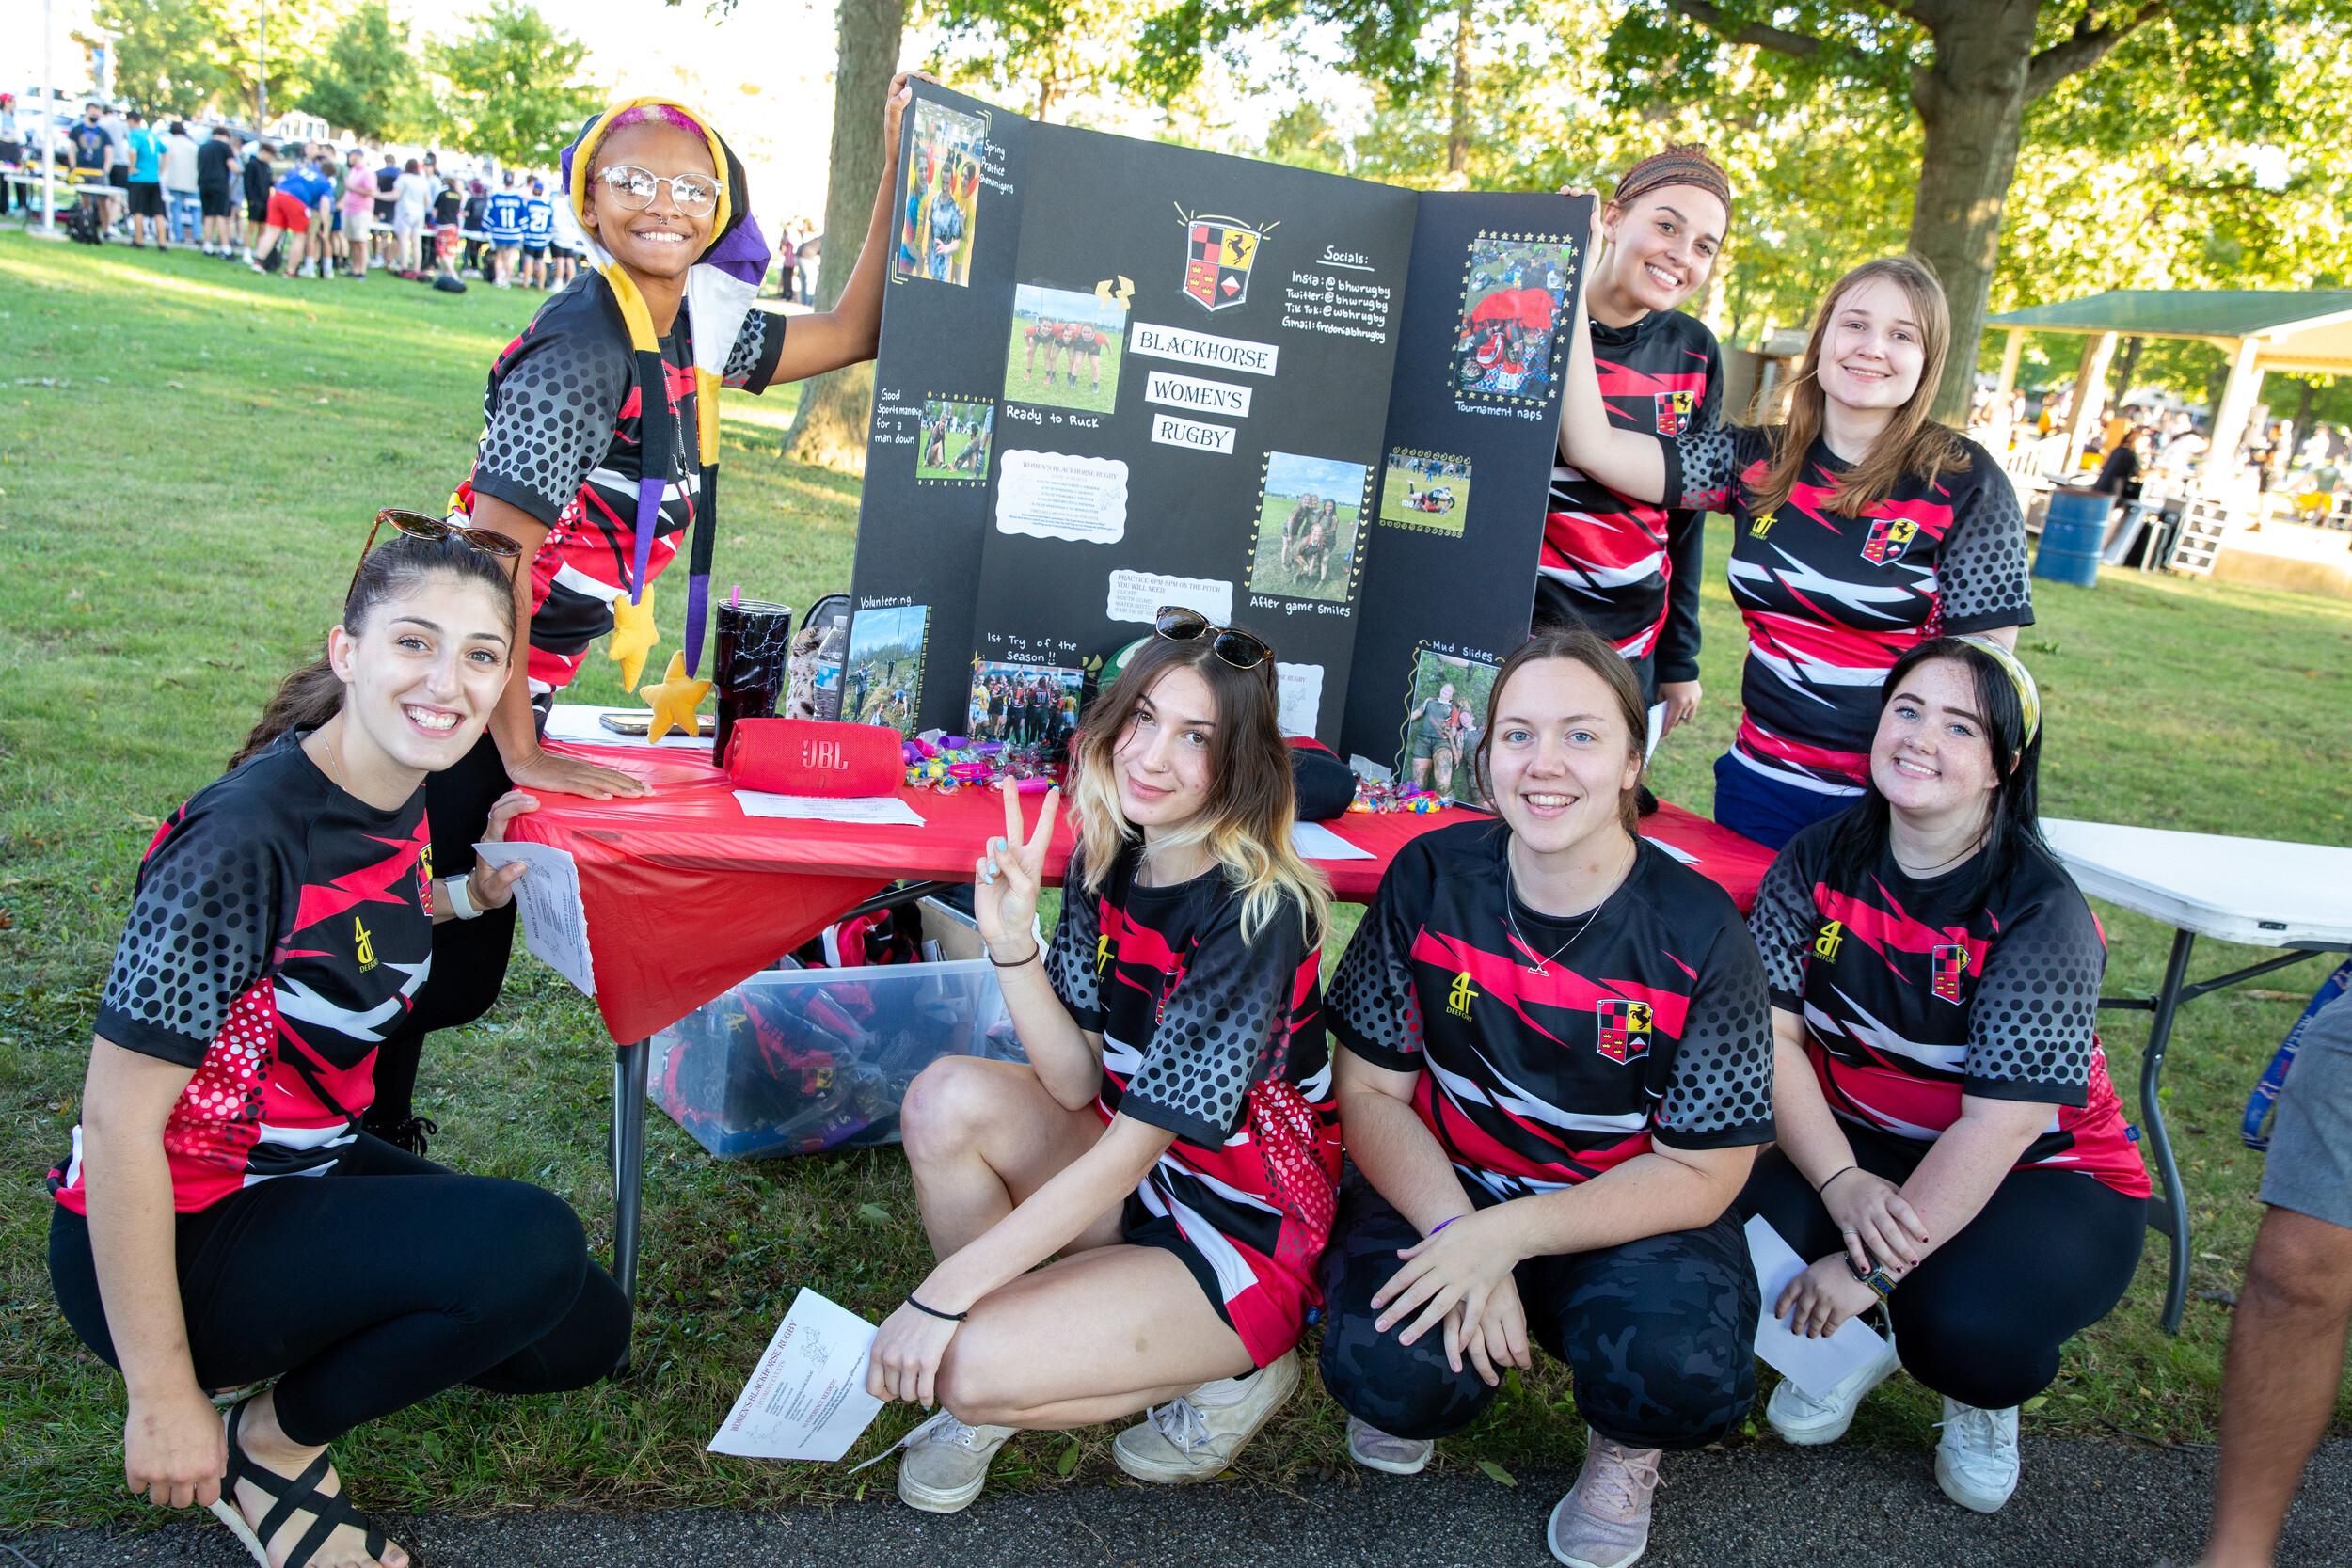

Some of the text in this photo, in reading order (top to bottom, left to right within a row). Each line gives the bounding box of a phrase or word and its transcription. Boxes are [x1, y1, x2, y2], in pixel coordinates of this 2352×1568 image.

[984, 139, 1006, 161] Spring
[981, 156, 1005, 176] Practice
[979, 174, 1014, 195] Shenanigans
[1324, 245, 1369, 264] Socials:
[1139, 331, 1269, 369] BLACKHORSE
[881, 388, 901, 401] Good
[1154, 379, 1243, 410] WOMEN'S
[877, 403, 922, 420] Sportsmanship
[1006, 405, 1099, 428] Ready to Ruck
[1455, 400, 1542, 422] Tournament naps
[876, 417, 902, 430] for a
[874, 434, 915, 444] man down
[1160, 421, 1230, 448] RUGBY
[1401, 499, 1414, 508] me
[1118, 574, 1148, 584] PRACTICE
[1131, 583, 1147, 591] WILL
[860, 590, 915, 609] Volunteering!
[1250, 596, 1280, 608] After
[1286, 602, 1313, 616] game
[1009, 635, 1026, 649] Try
[1036, 638, 1051, 648] of
[1058, 641, 1077, 651] the
[1432, 641, 1454, 652] Mud
[802, 740, 849, 770] JBL
[1446, 1006, 1473, 1022] DEEFORT
[730, 1400, 753, 1432] WOMEN'S
[749, 1348, 781, 1402] BLACKHORSE
[777, 1319, 798, 1349] RUGBY
[756, 1380, 774, 1409] UPCOMING
[769, 1359, 786, 1382] EVENTS
